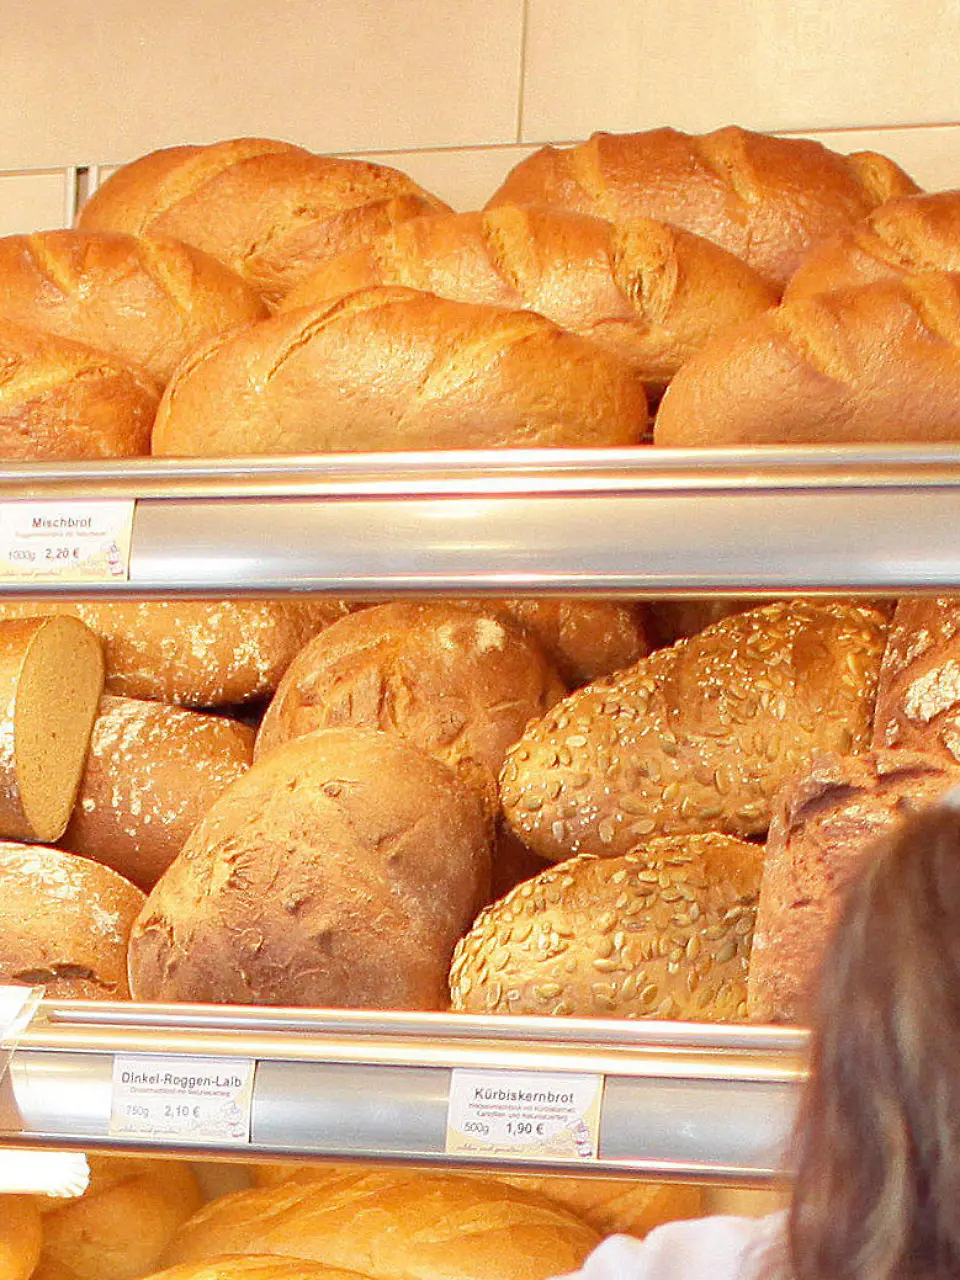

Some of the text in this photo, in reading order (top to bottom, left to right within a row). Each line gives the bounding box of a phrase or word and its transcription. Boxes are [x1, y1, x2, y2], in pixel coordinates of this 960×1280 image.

[32, 516, 92, 528] Mischbrot
[45, 547, 69, 559] 2,20
[73, 547, 80, 558] €
[121, 1071, 242, 1089] Dinkel-Roggen-Laib
[475, 1088, 574, 1104] Kürbiskernbrot
[164, 1104, 189, 1118] 2,10
[193, 1106, 200, 1118] €
[464, 1122, 545, 1136] 500g 1,90 €
